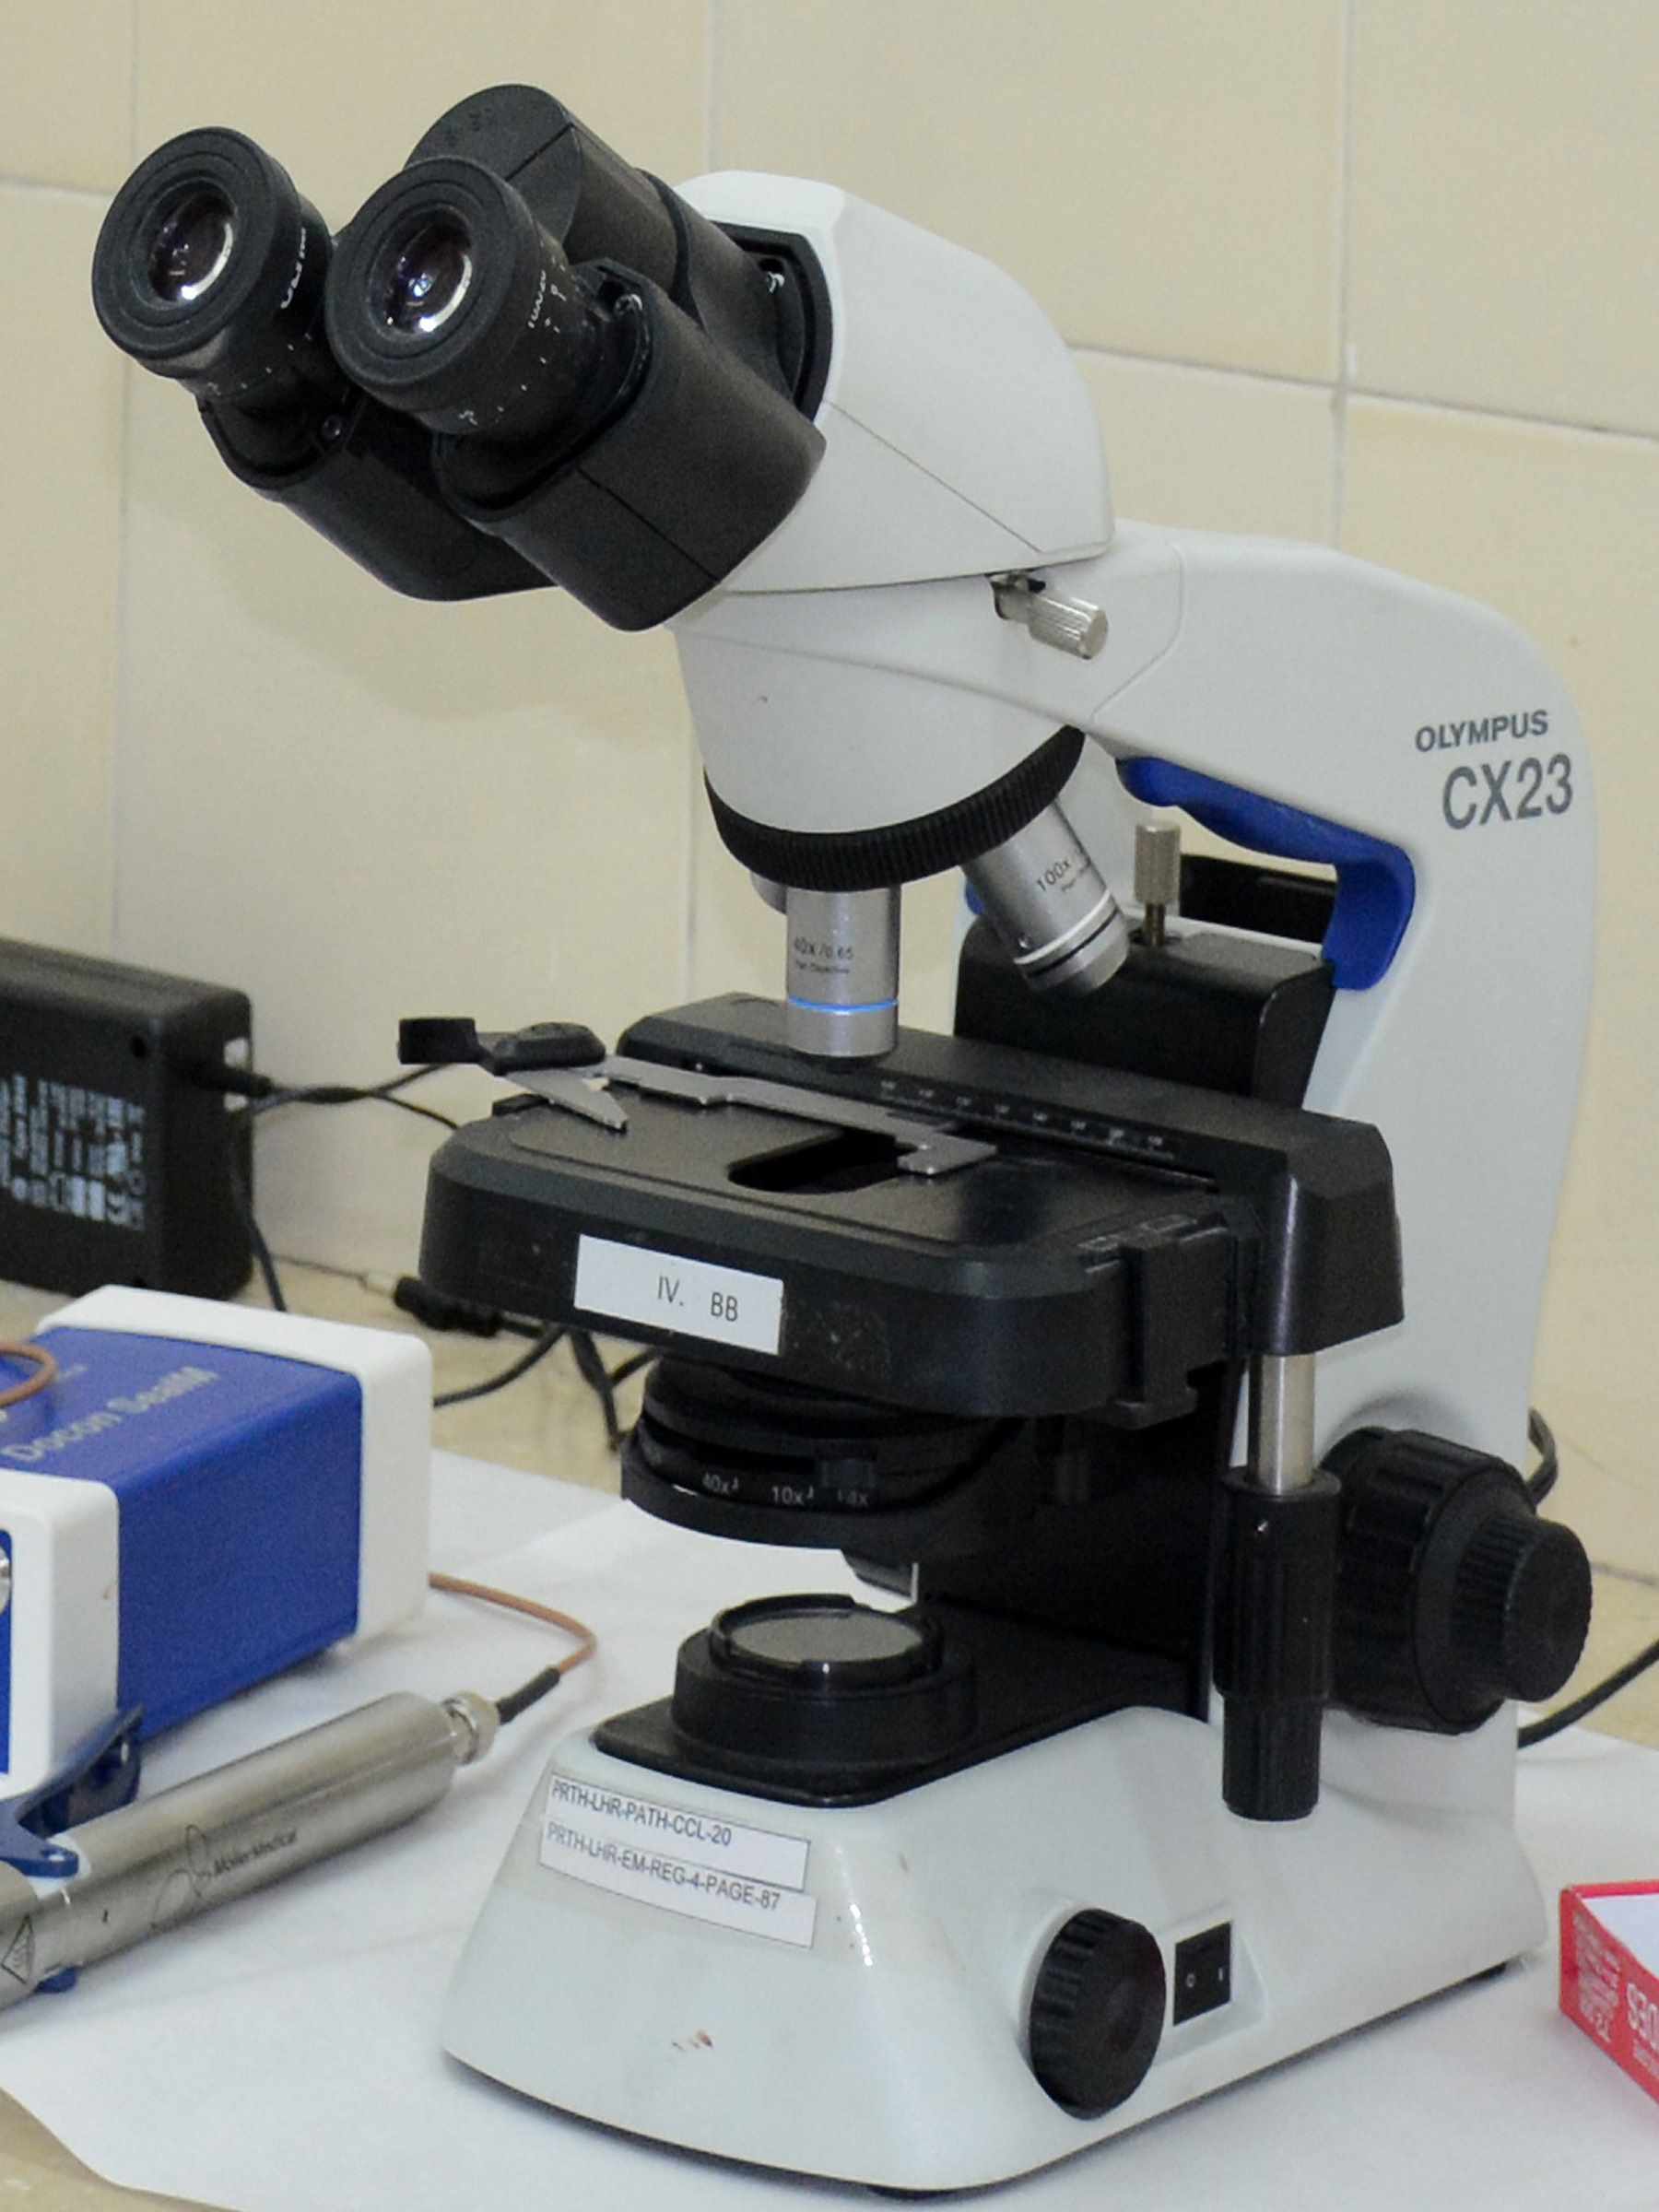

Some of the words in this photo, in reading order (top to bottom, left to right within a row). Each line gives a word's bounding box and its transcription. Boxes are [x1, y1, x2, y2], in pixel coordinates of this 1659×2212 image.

[1415, 709, 1549, 752] OLYMPUS
[1442, 752, 1573, 830] CX23
[657, 1276, 685, 1307] IV.
[711, 1292, 738, 1322] BB
[552, 1779, 733, 1847] PRTH-LHR-PATH-CCL-20
[547, 1820, 782, 1911] PRTH-LHR-EM-REG-4-PAGE-87
